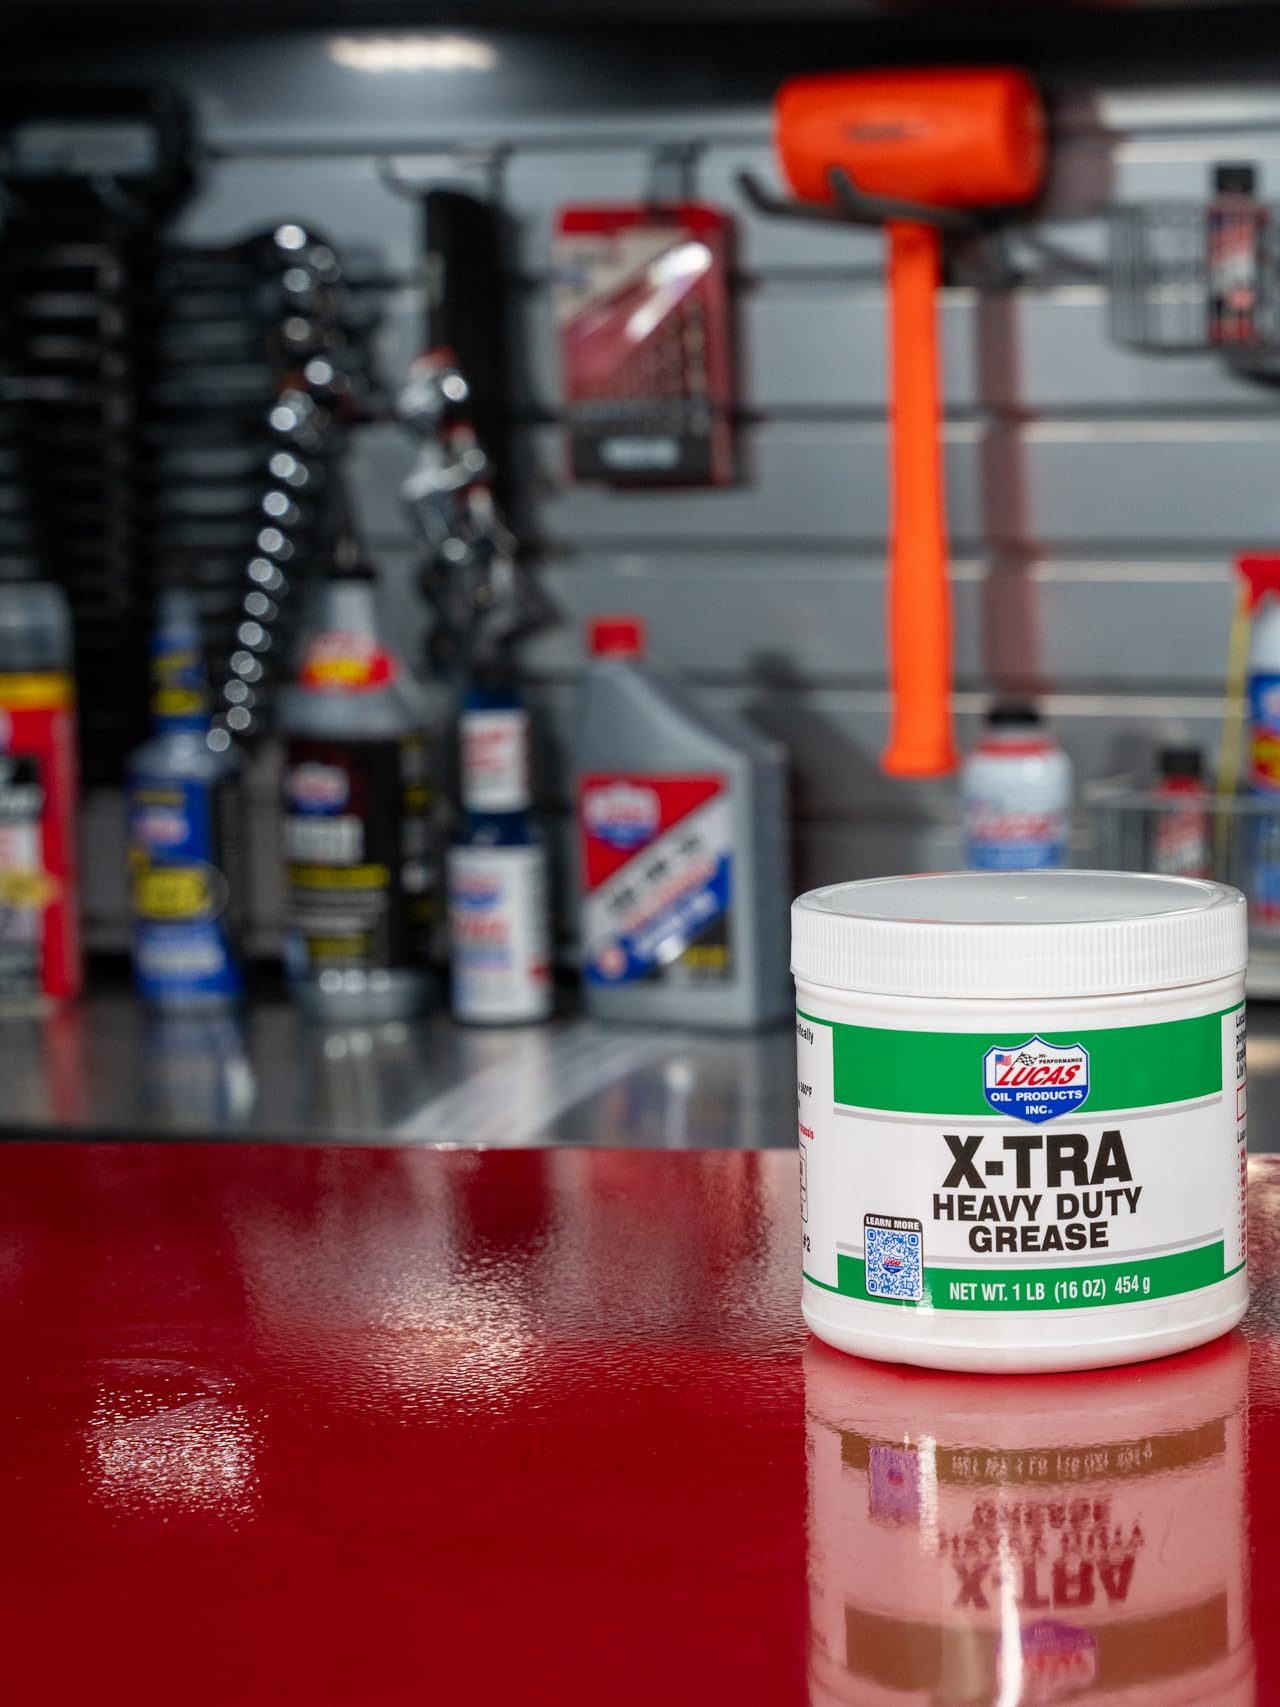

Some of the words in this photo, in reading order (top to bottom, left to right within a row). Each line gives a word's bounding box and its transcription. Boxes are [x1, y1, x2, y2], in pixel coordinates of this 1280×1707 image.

[996, 1065, 1081, 1086] LUCAS
[991, 1092, 1012, 1101] OIL
[1016, 1090, 1083, 1101] PRODUCTS
[942, 1130, 1133, 1188] X-TRA
[933, 1193, 1043, 1222] HEAVY
[1056, 1186, 1142, 1220] DUTY
[866, 1216, 892, 1228] LEARN
[894, 1220, 920, 1230] MORE
[969, 1221, 1109, 1253] GREASE
[950, 1282, 977, 1300] NET
[981, 1283, 1007, 1301] WT.
[1012, 1283, 1020, 1300] 1
[1026, 1283, 1045, 1300] LB
[1055, 1281, 1078, 1303] (16
[1082, 1279, 1106, 1300] OZ)
[1115, 1275, 1139, 1293] 454
[1143, 1276, 1151, 1294] g
